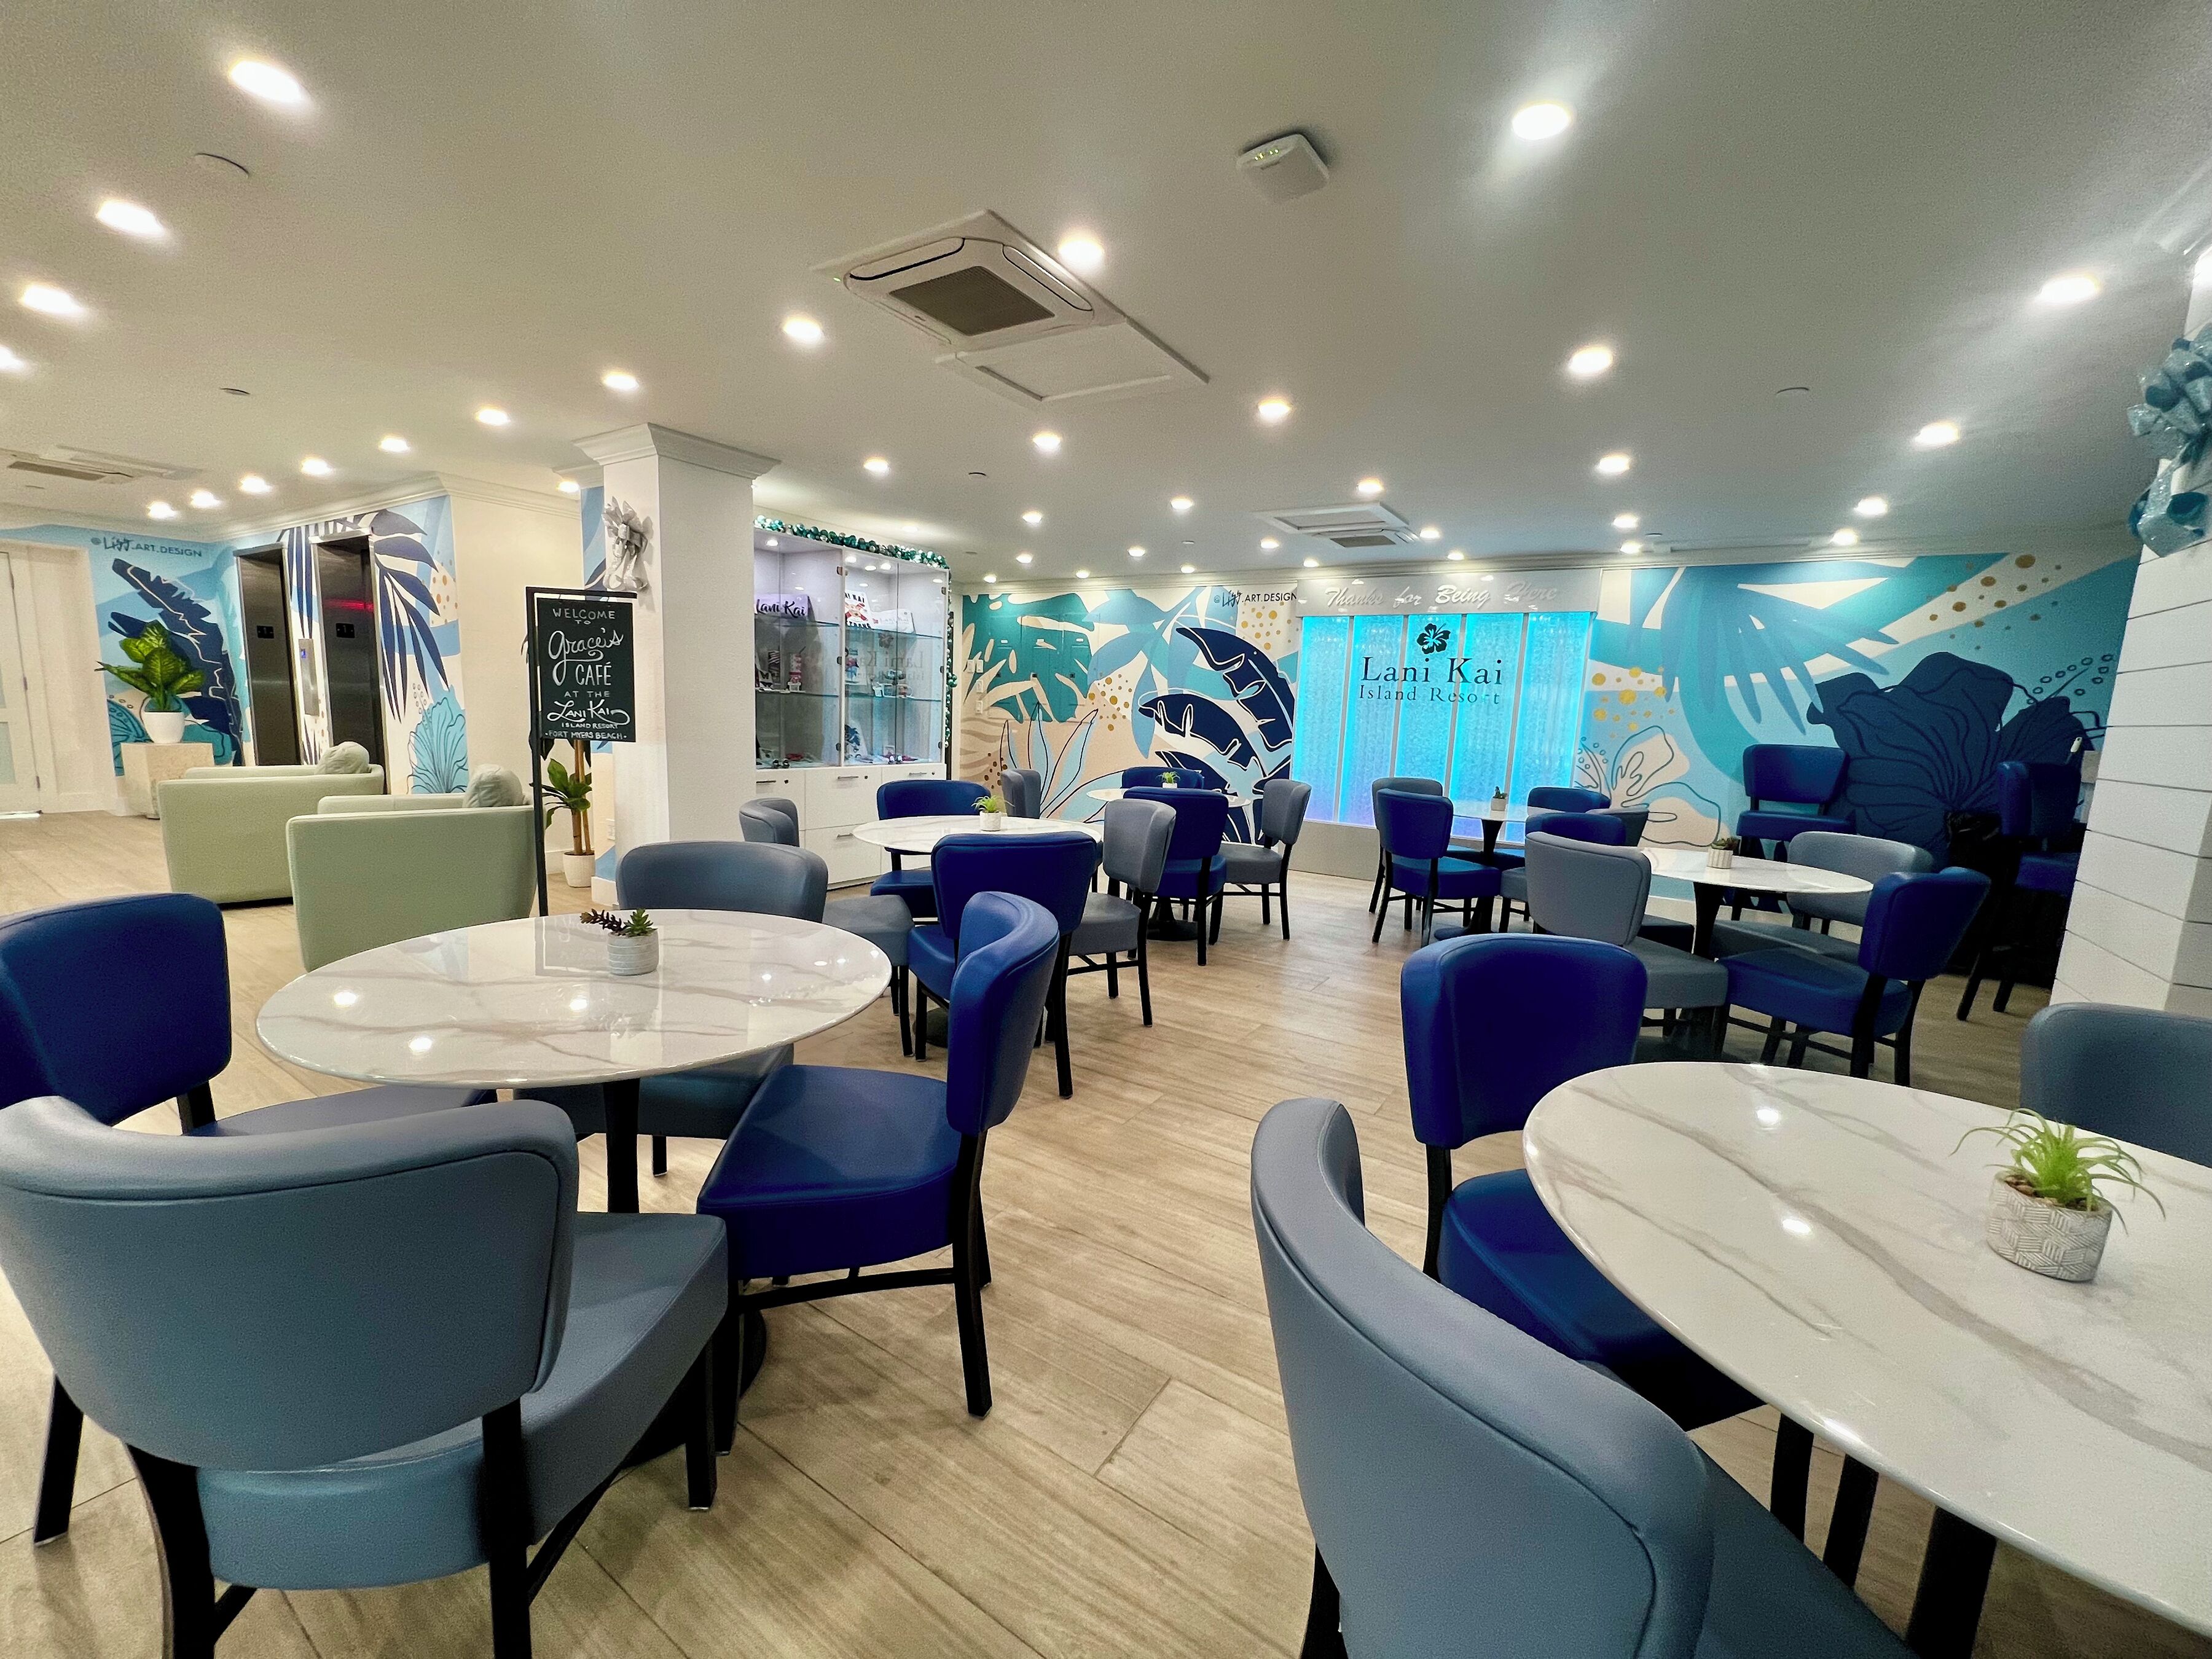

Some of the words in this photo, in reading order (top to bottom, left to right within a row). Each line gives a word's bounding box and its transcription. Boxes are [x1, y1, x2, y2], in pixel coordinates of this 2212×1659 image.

[1325, 587, 1383, 608] Thanks
[1393, 586, 1422, 609] for
[1435, 584, 1491, 610] Being
[1507, 580, 1558, 602] Here
[552, 608, 616, 619] WELCOME
[756, 599, 780, 614] Lani
[783, 600, 806, 618] Kai
[575, 662, 612, 686] CAFÉ
[1360, 656, 1430, 682] Lani
[1447, 657, 1502, 684] Kai
[1359, 684, 1416, 701] Island
